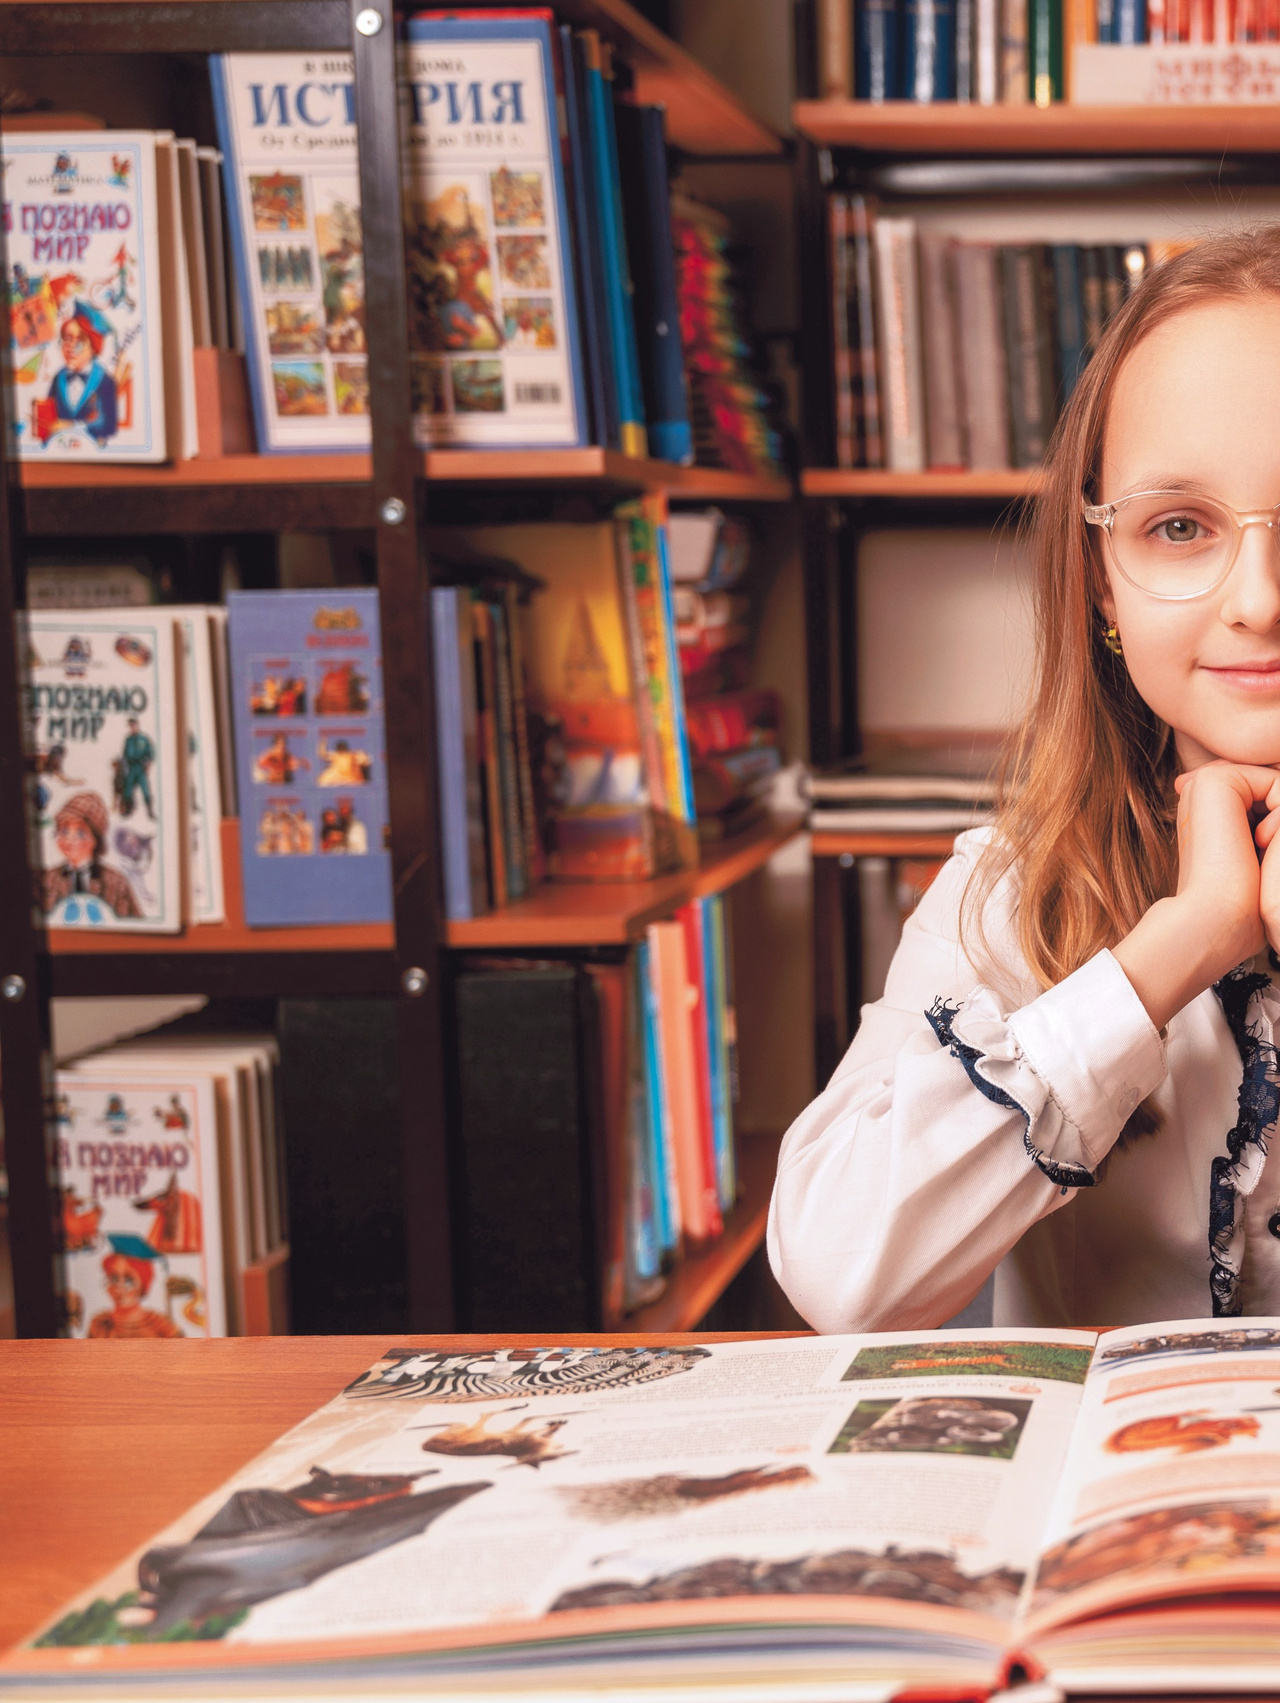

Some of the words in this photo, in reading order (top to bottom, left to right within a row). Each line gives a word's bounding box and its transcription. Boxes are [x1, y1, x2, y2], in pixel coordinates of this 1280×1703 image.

[247, 81, 526, 128] ИСТРИЯ
[21, 202, 131, 232] ПОЗНАЮ
[33, 234, 90, 262] МИР
[31, 682, 147, 714] ПОЗНАЮ
[47, 714, 105, 740] МИР
[77, 1141, 190, 1169] ПОЗНАЮ
[92, 1170, 148, 1195] МИР
